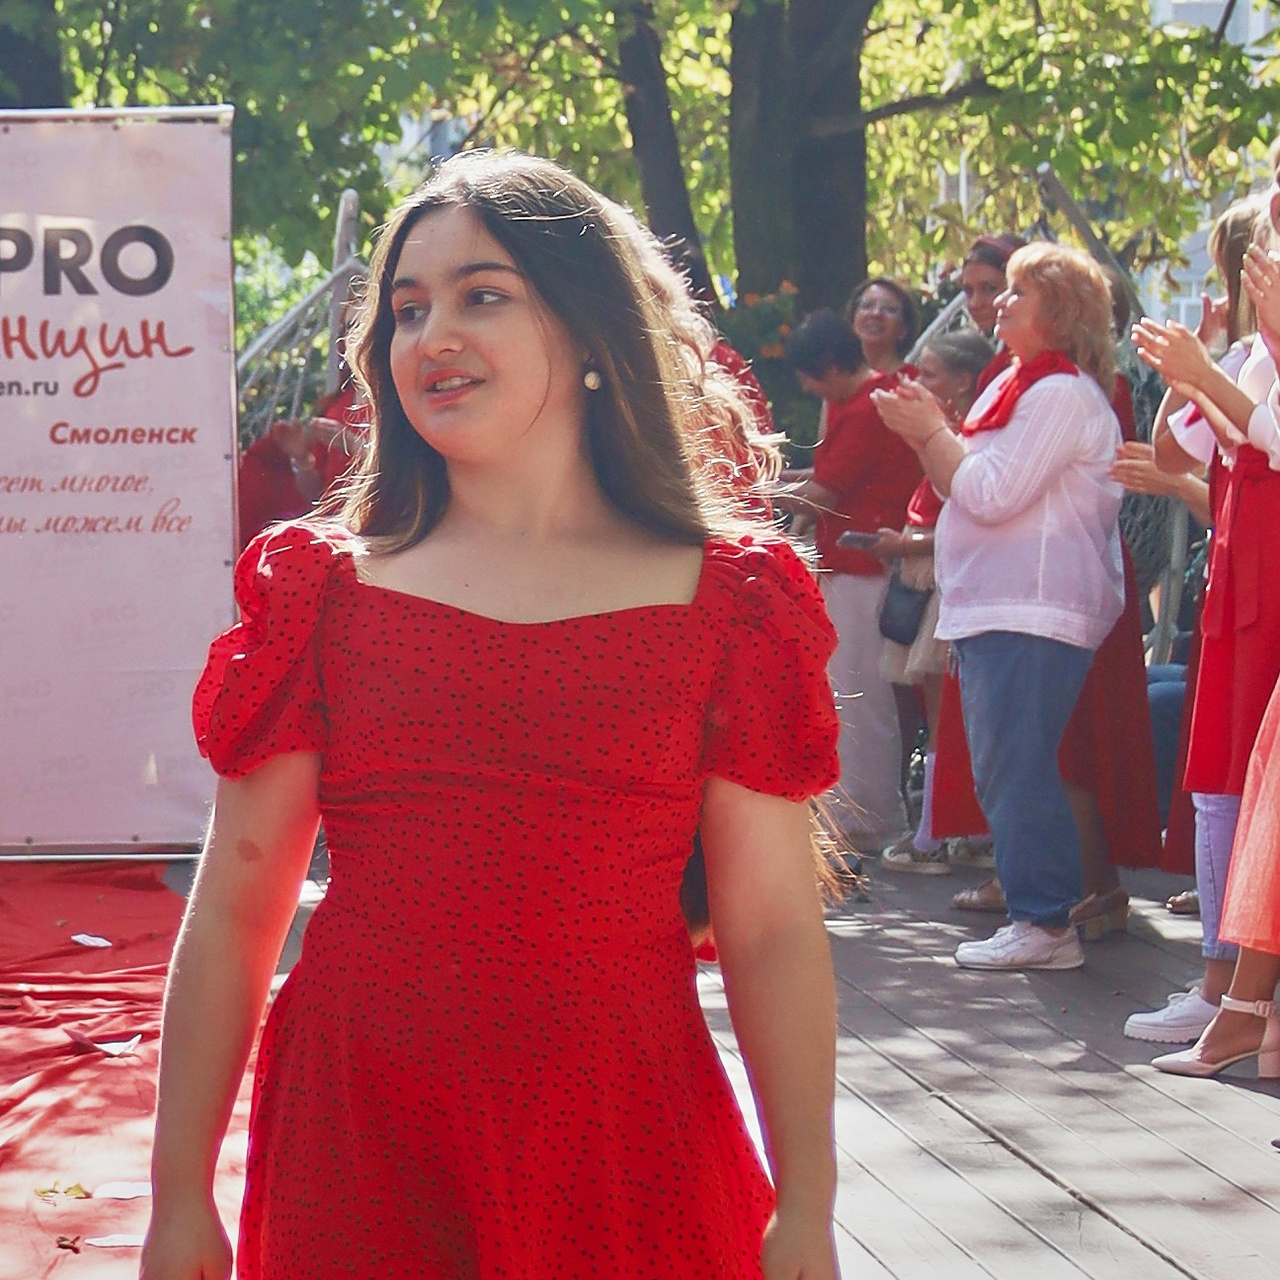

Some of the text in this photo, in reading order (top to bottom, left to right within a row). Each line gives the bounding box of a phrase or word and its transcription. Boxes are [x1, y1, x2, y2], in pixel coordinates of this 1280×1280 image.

[49, 421, 198, 445] Смоленск
[34, 514, 143, 534] можем
[150, 496, 193, 534] все
